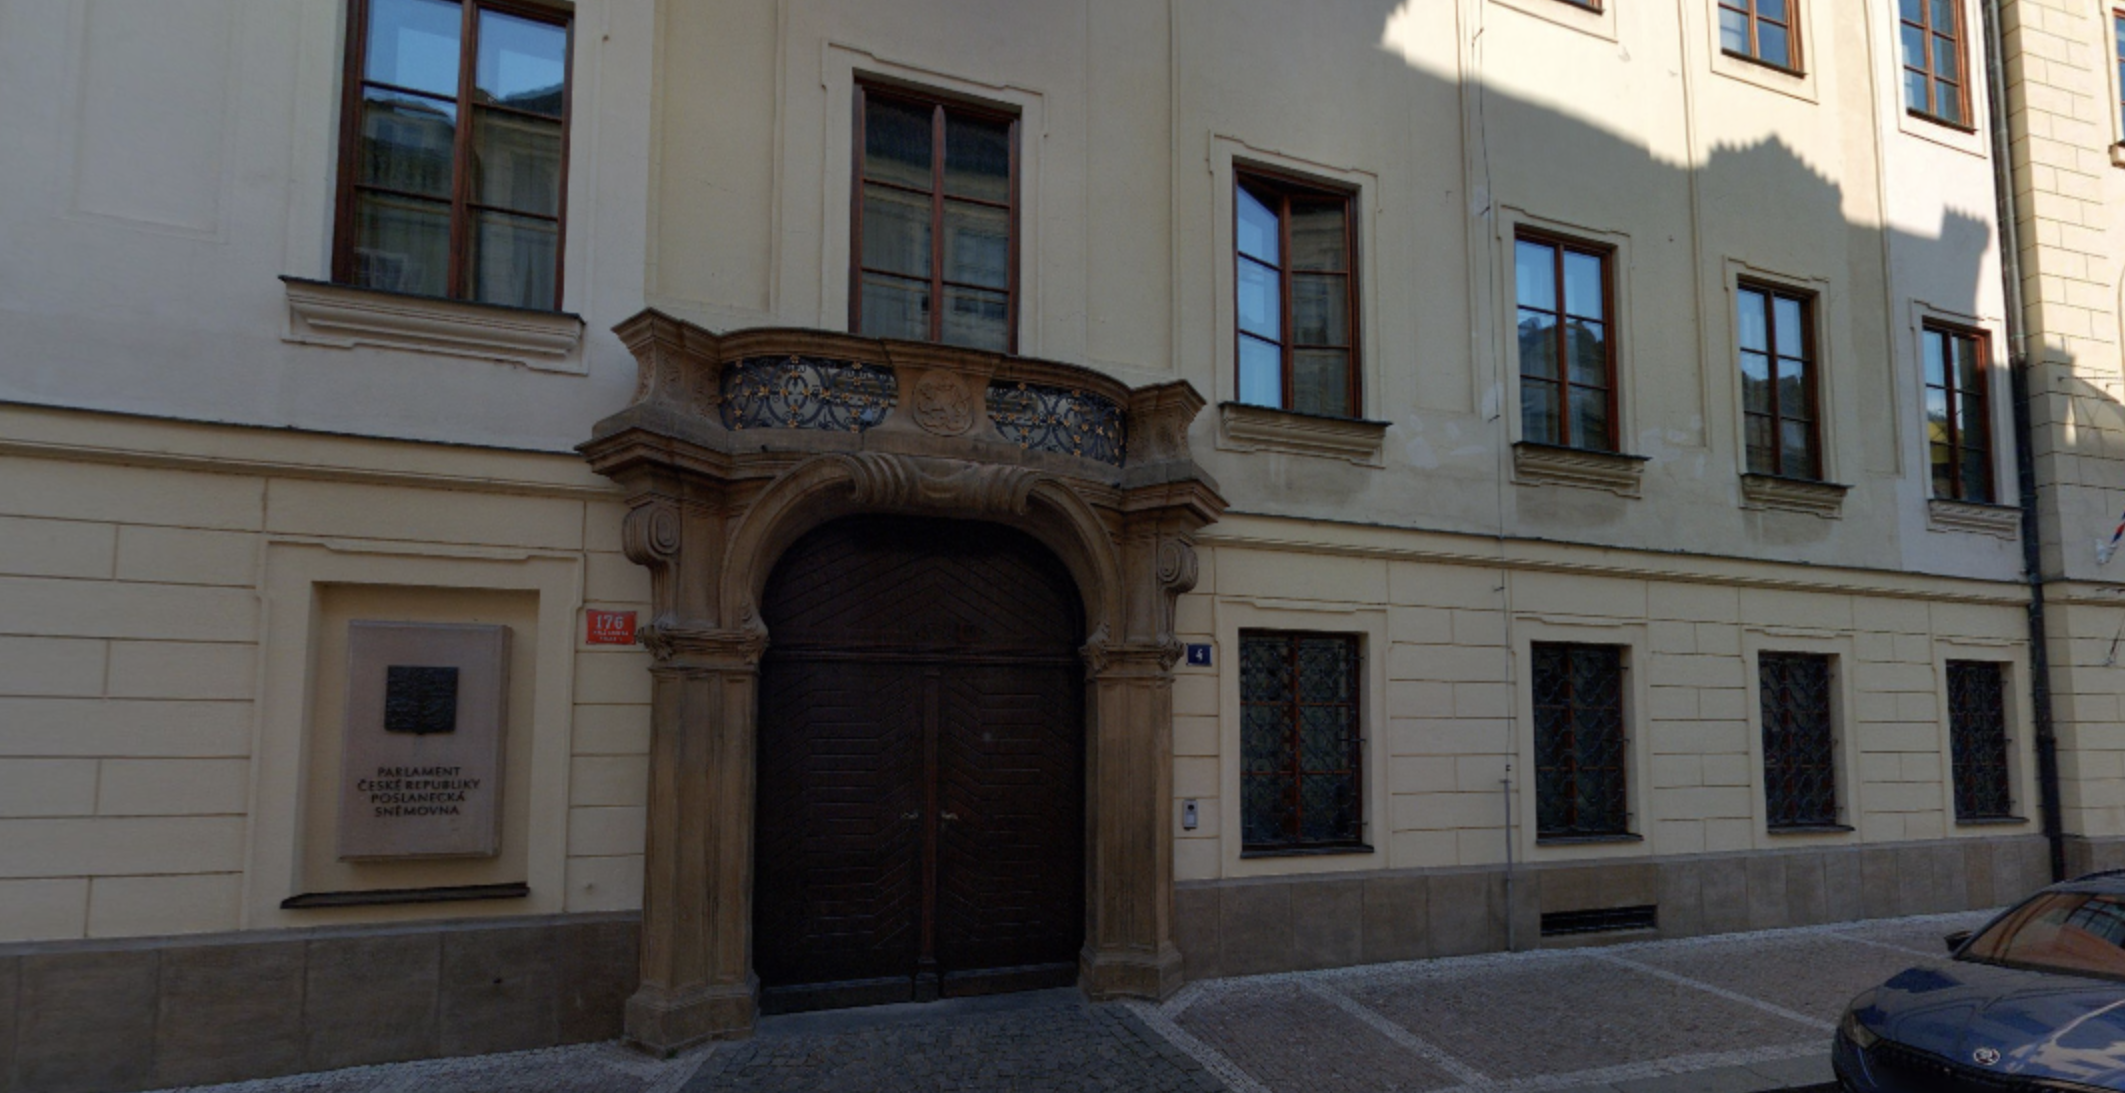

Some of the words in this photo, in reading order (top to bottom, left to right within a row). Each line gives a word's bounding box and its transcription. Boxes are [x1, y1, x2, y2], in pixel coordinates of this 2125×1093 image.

[596, 614, 624, 630] 176
[1195, 648, 1203, 661] 4
[377, 766, 461, 778] PARLAMENT
[357, 778, 401, 792] ČESKÉ
[405, 779, 480, 791] REPUBLIKY
[371, 791, 465, 804] POSLANECKÁ
[374, 805, 460, 817] SNĚMOVNA
